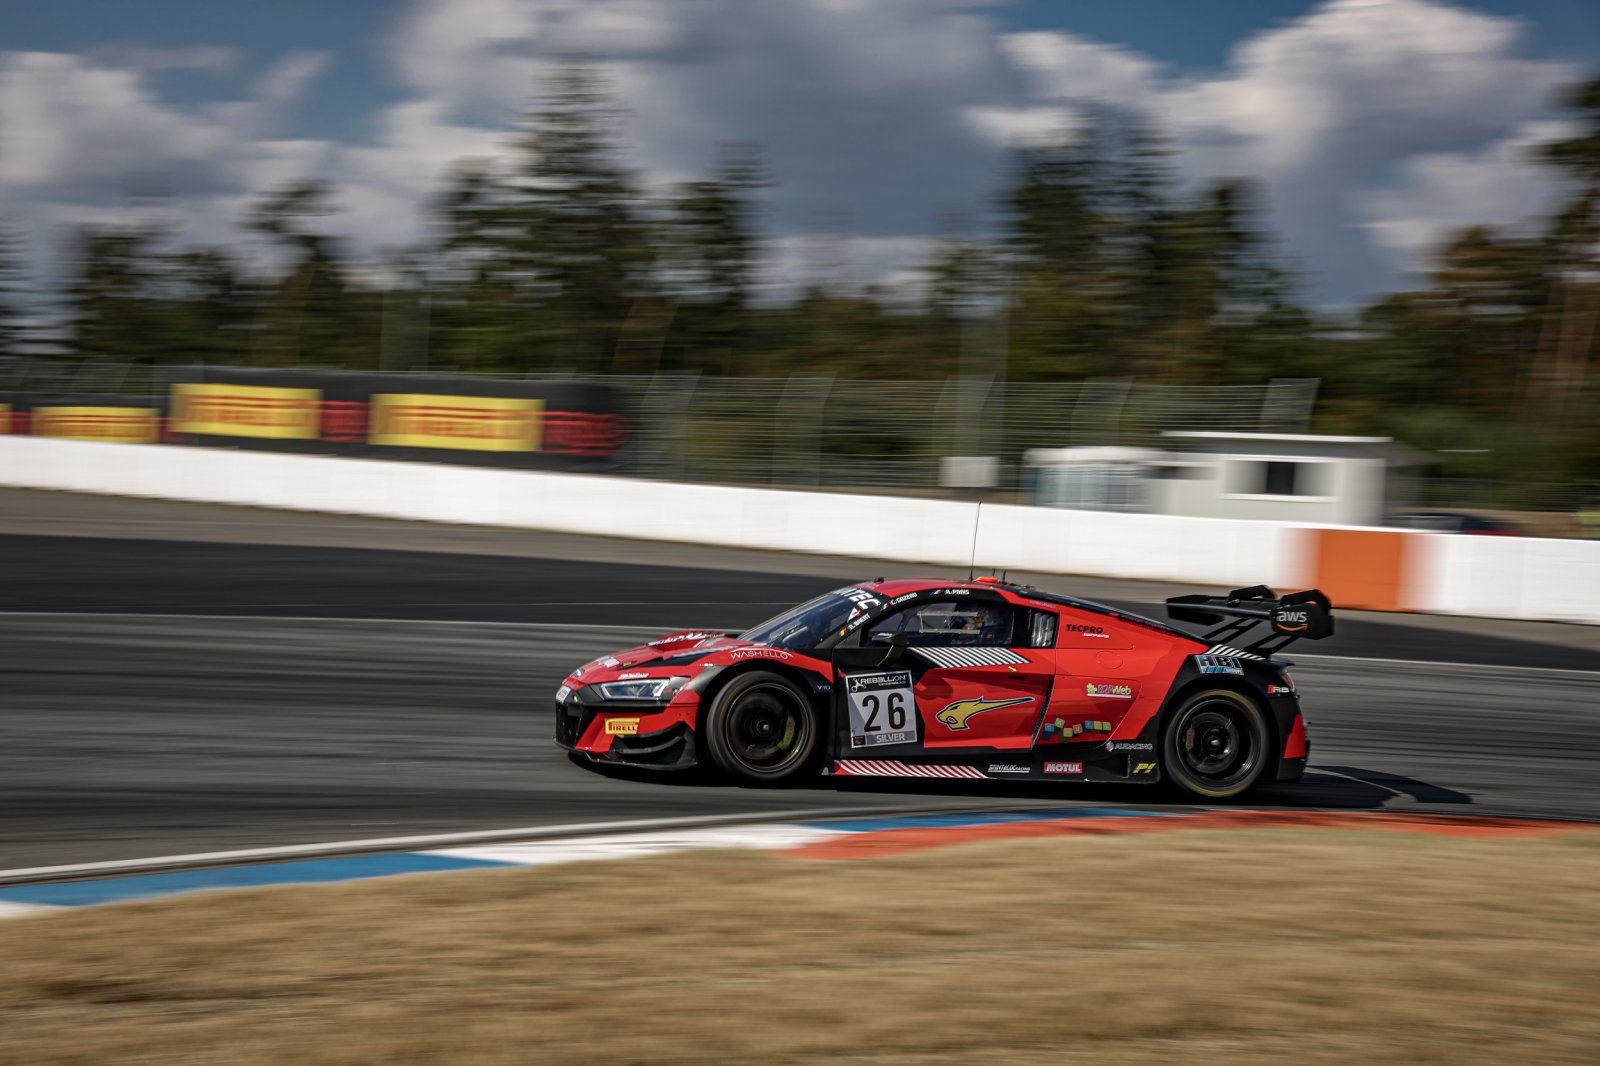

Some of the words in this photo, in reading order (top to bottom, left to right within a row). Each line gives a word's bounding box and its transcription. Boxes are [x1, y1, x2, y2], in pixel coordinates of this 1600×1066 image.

[1276, 611, 1308, 623] aws
[1066, 624, 1104, 633] TECPRO
[730, 649, 789, 660] WASHELLO
[860, 674, 906, 685] REBELLION
[862, 692, 906, 733] 26
[876, 732, 906, 743] SILVER
[1045, 763, 1081, 772] MOTUL
